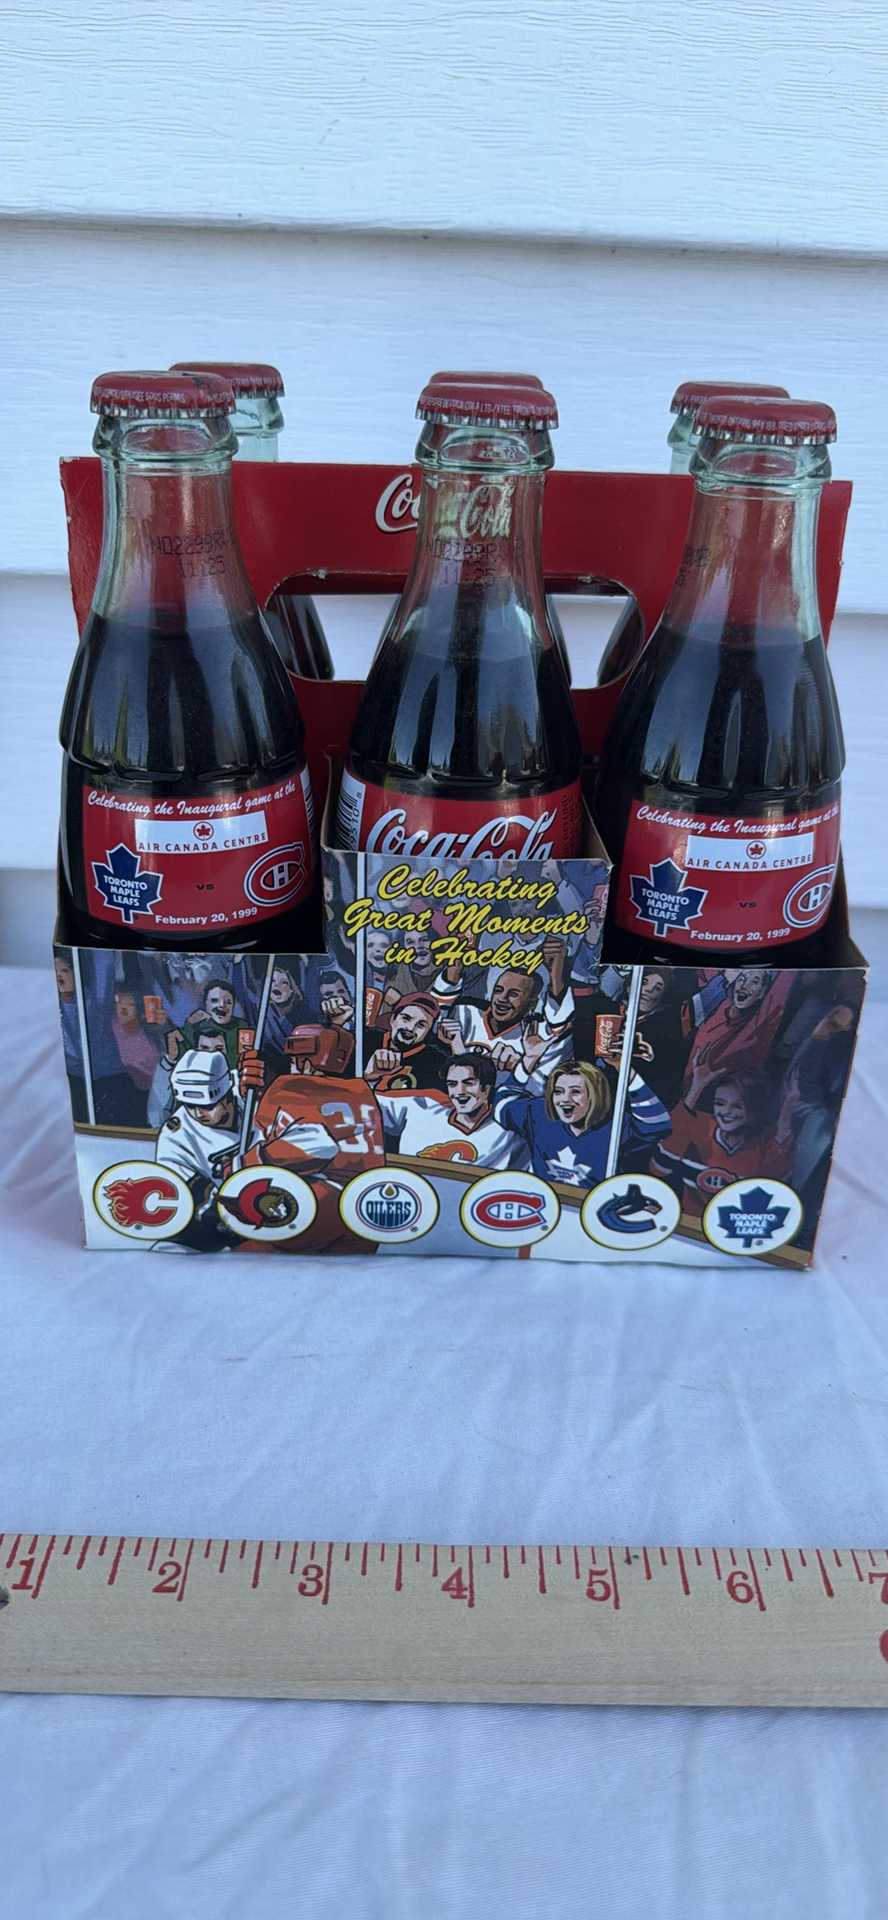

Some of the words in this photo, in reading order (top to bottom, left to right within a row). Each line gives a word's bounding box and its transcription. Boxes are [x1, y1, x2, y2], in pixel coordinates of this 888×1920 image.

[88, 790, 151, 817] Celebrating
[154, 802, 174, 815] the
[176, 797, 242, 817] Inaugural
[245, 795, 272, 812] game
[274, 787, 284, 800] at
[285, 780, 296, 796] the
[637, 805, 707, 834] Celebrating
[710, 821, 730, 833] the
[734, 819, 796, 837] Inaugural
[798, 816, 822, 833] game
[823, 811, 832, 822] at
[830, 802, 840, 818] the
[138, 842, 159, 851] AIR
[165, 841, 218, 852] CANADA
[224, 833, 267, 849] CENTRE
[687, 858, 709, 868] AIR
[715, 859, 768, 870] CANADA
[773, 854, 812, 868] CENTRE
[103, 874, 148, 891] TORONTO
[377, 864, 557, 910] Celebrating
[110, 885, 141, 898] MAPLE
[641, 888, 690, 905] TORONTO
[112, 895, 140, 907] LEAFS
[647, 899, 679, 913] MAPLE
[155, 914, 207, 926] February
[211, 913, 229, 923] 20,
[232, 907, 258, 920] 1999
[343, 898, 433, 936] Great
[444, 902, 590, 935] Moments
[648, 909, 677, 921] LEAFS
[690, 930, 743, 942] February
[746, 932, 763, 942] 20,
[767, 927, 790, 939] 1999
[384, 942, 418, 964] in
[431, 938, 544, 974] Hockey
[366, 1201, 412, 1227] OILERS
[729, 1212, 776, 1221] TORONTO
[734, 1220, 766, 1228] MAPLE
[736, 1227, 765, 1235] LEAFS
[11, 1557, 35, 1590] 1
[152, 1561, 182, 1593] 2
[298, 1564, 324, 1596] 3
[441, 1566, 468, 1599] 4
[586, 1568, 611, 1601] 5
[726, 1570, 754, 1603] 6
